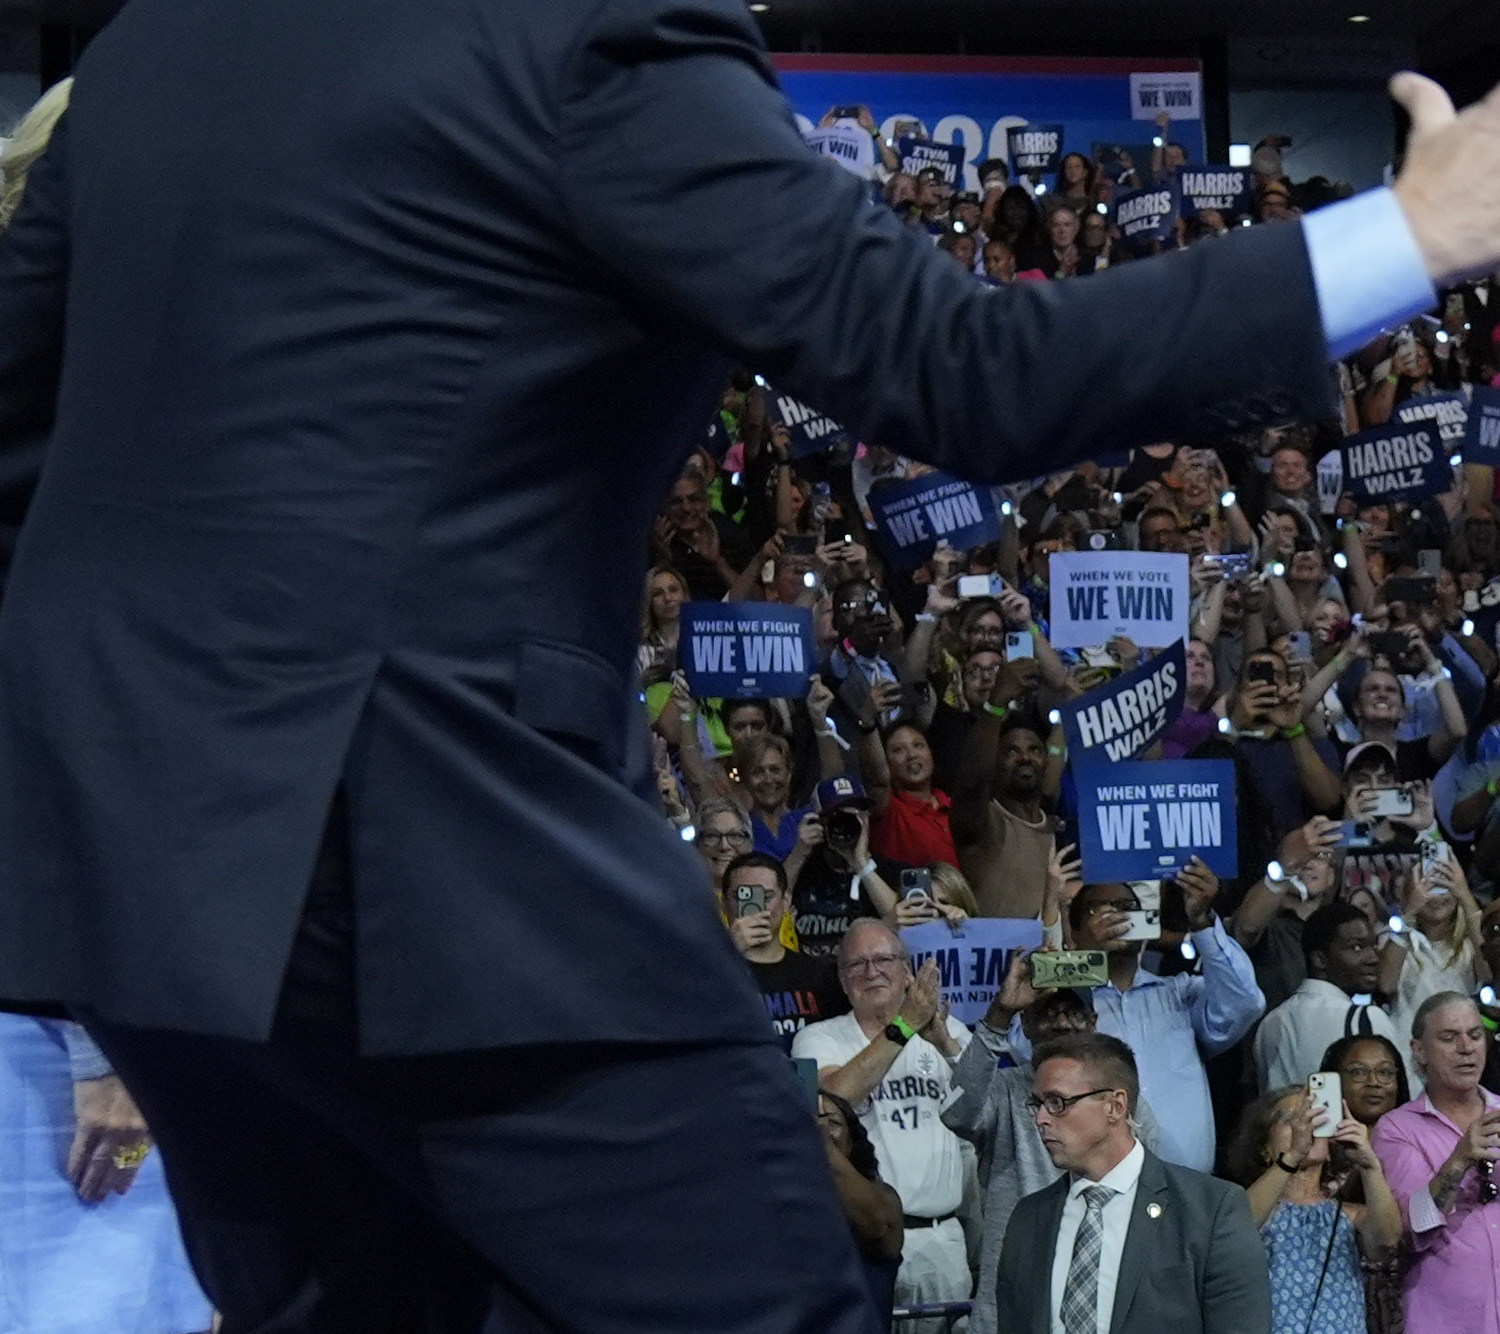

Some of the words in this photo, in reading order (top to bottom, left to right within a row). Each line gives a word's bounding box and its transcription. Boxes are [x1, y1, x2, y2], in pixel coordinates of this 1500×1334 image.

[1138, 90, 1160, 108] WE
[1163, 89, 1193, 107] WIN
[1182, 173, 1244, 199] HARRIS
[1116, 192, 1172, 224] HARRIS
[1193, 194, 1235, 210] WALZ
[1349, 431, 1435, 478] HARRIS
[1364, 470, 1426, 495] WALZ
[882, 499, 916, 516] WHEN
[936, 481, 973, 501] FIGHT
[886, 511, 931, 549] WE
[932, 491, 984, 538] WIN
[1070, 571, 1108, 583] WHEN
[1112, 571, 1132, 583] WE
[1136, 571, 1171, 583] VOTE
[1068, 587, 1111, 622] WE
[1117, 587, 1174, 622] WIN
[693, 620, 732, 634] WHEN
[737, 621, 759, 634] WE
[763, 621, 802, 636] FIGHT
[692, 635, 738, 674] WE
[743, 636, 805, 674] WIN
[1076, 666, 1179, 748] HARRIS
[1103, 710, 1169, 763] WALZ
[1097, 785, 1146, 801] WHEN
[1149, 784, 1178, 800] WE
[1181, 783, 1220, 799] FIGHT
[1097, 803, 1151, 852] WE
[1157, 801, 1222, 850] WIN
[765, 993, 820, 1018] MALA
[772, 1019, 807, 1037] 024
[890, 1106, 920, 1131] 47
